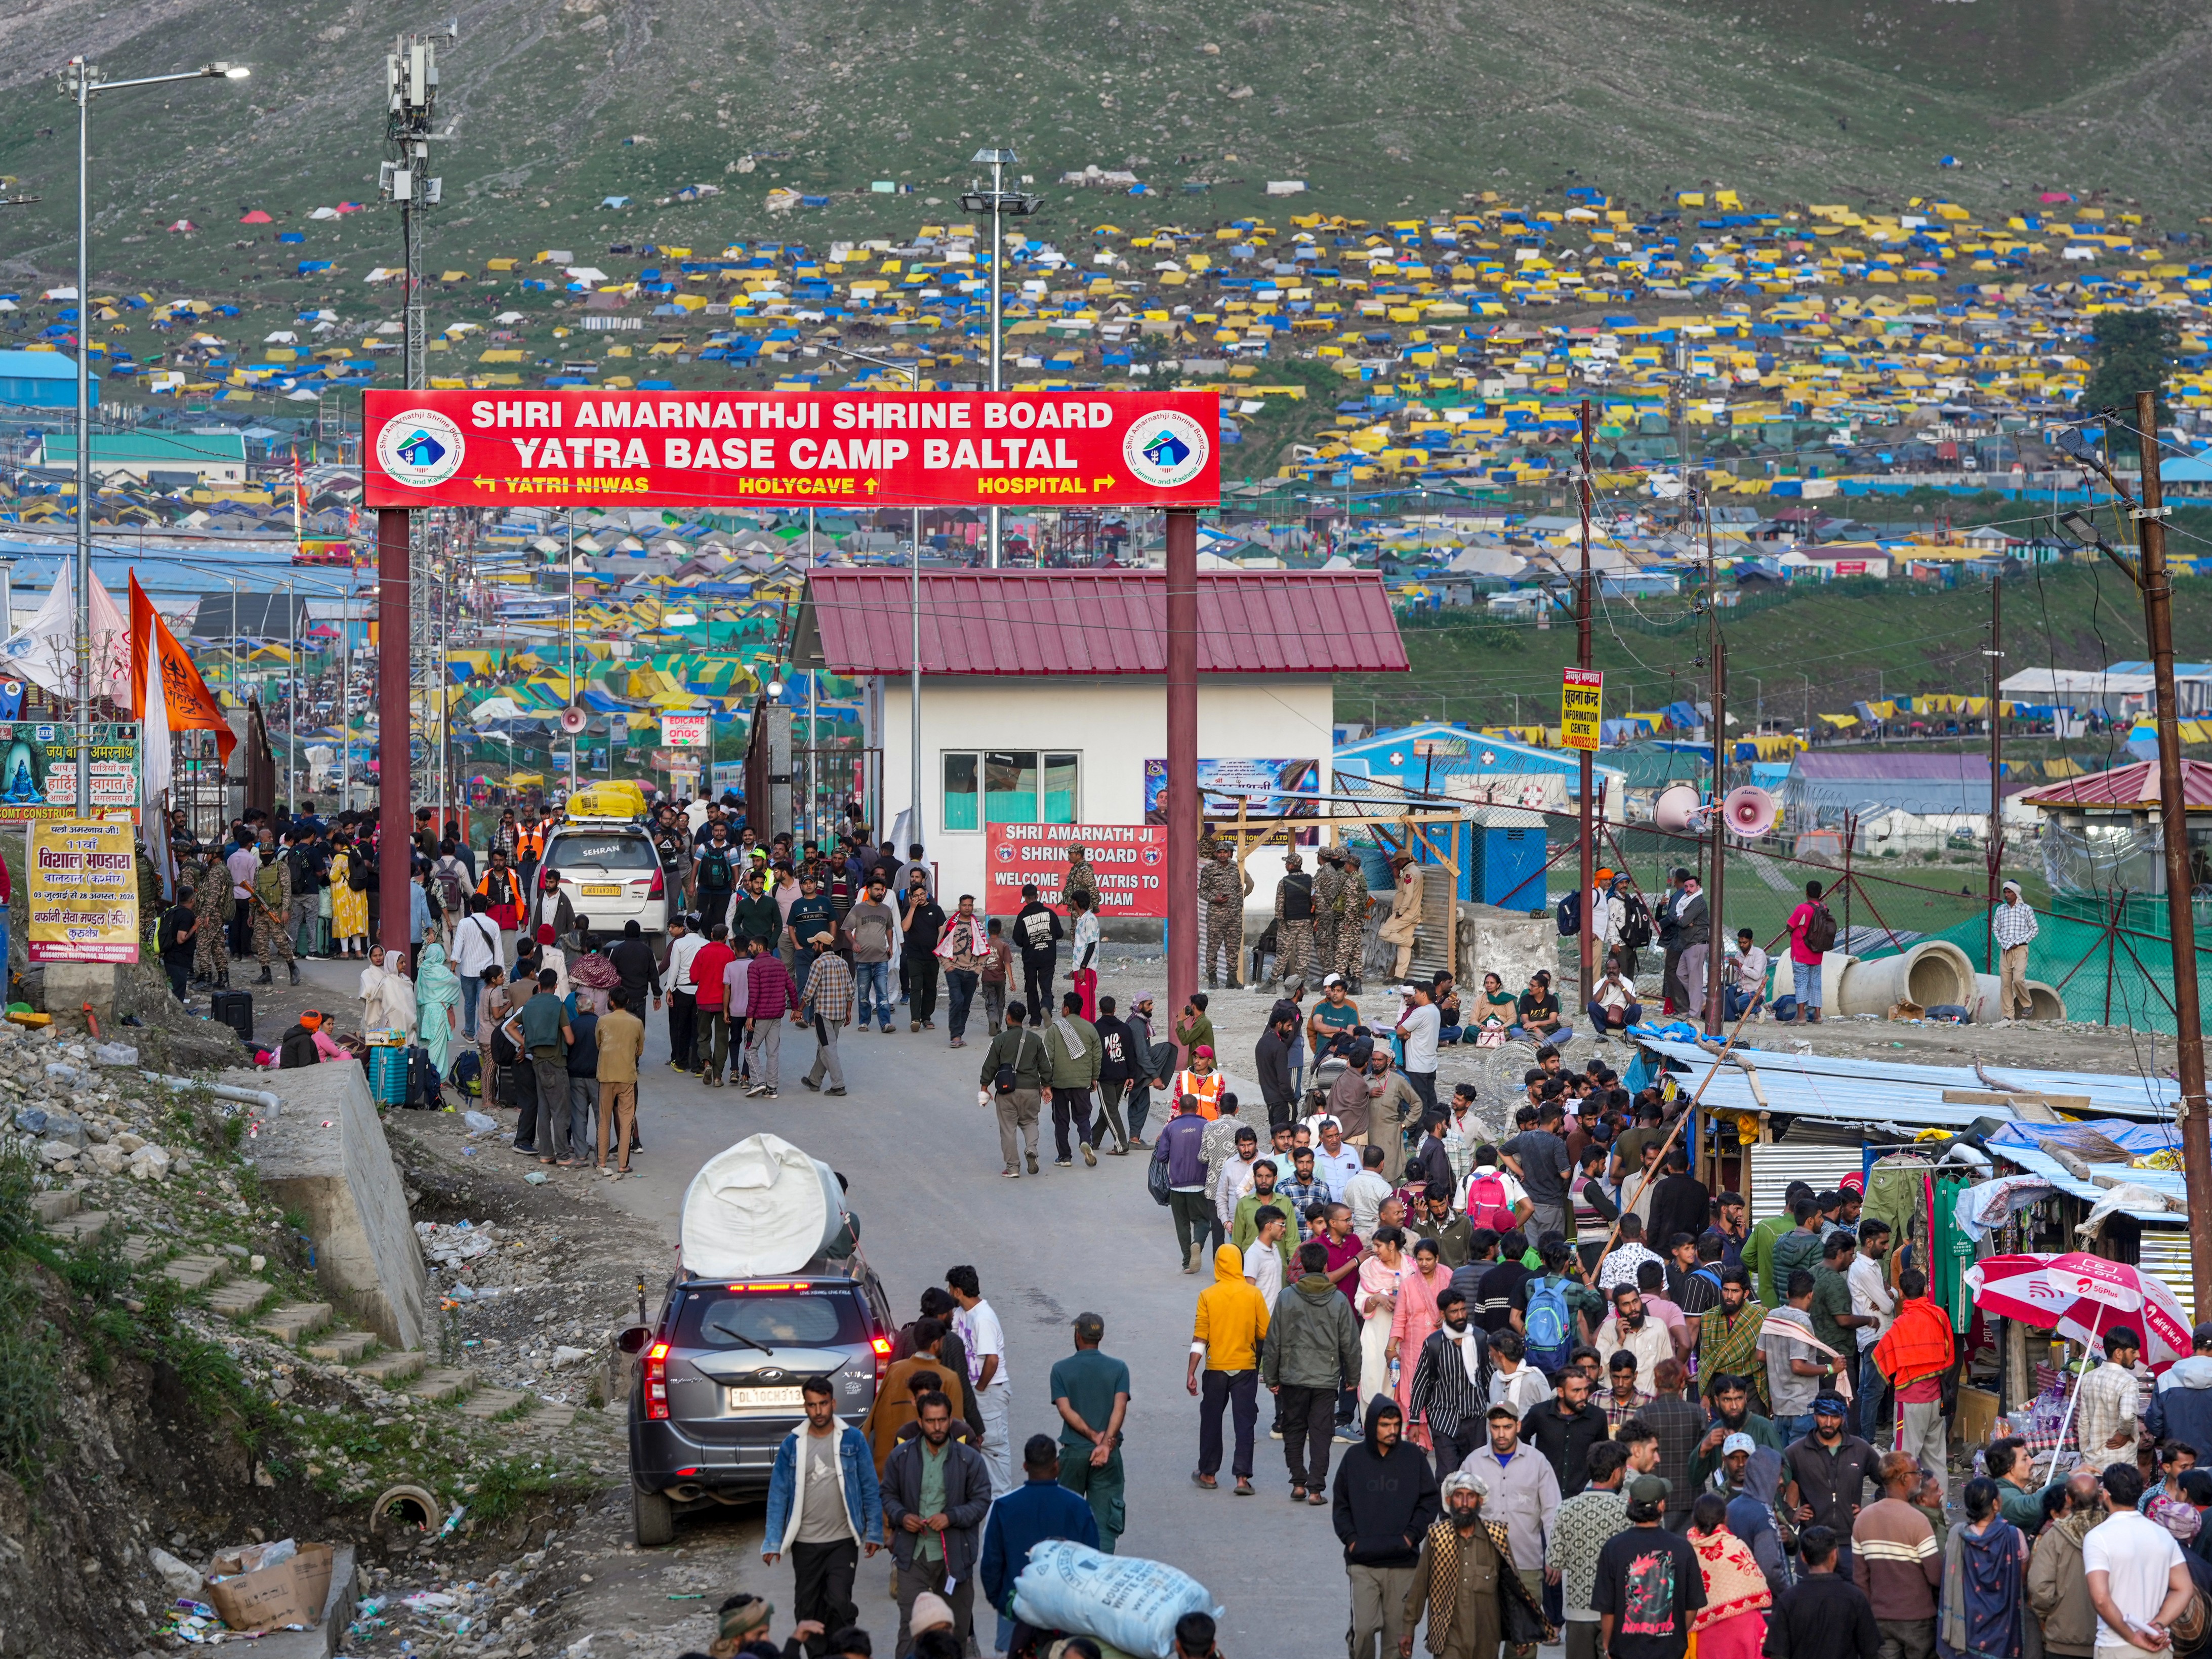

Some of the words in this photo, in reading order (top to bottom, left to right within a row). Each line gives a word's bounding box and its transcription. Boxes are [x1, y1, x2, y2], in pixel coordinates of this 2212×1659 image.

[472, 401, 561, 428] SHRI
[574, 401, 819, 429] AMARNATHJI
[833, 402, 971, 429] SHRINE
[985, 402, 1113, 429] BOARD
[380, 434, 388, 449] Shri
[386, 412, 424, 434] Amarnathji
[427, 412, 450, 428] Shrine
[449, 427, 462, 449] Board
[1126, 435, 1134, 449] Shri
[1132, 413, 1169, 434] Amarnathji
[1172, 413, 1194, 428] Shrine
[1194, 428, 1206, 449] Board
[511, 438, 651, 468] YATRA
[665, 438, 775, 469] BASE
[789, 438, 909, 470] CAMP
[924, 438, 1078, 471] BALTAL
[388, 467, 411, 483] Jammu
[428, 466, 454, 483] Kashmir
[1133, 468, 1156, 483] Jammu
[1173, 466, 1198, 483] Kashmir
[504, 477, 568, 493] YATRI
[577, 477, 649, 493] NIWAS
[739, 477, 855, 494] HOLYCAVE
[978, 477, 1087, 494] HOSPITAL
[1566, 671, 1581, 684] जयपुर
[1582, 673, 1600, 683] भण्डारा
[1565, 689, 1583, 708] सूचना
[1584, 687, 1599, 707] केन्द्र
[1564, 709, 1597, 722] INFORMATION
[1571, 723, 1590, 734] CENTRE
[1562, 734, 1597, 749] 9414008822-23
[46, 746, 63, 758] जय
[91, 746, 133, 758] अमरनाथ
[52, 764, 67, 772] आप
[91, 763, 116, 772] यात्रियों
[119, 764, 130, 772] का
[90, 776, 122, 791] स्वागत
[126, 774, 134, 791] है
[49, 793, 73, 802] आपकी
[94, 793, 122, 802] मंगलमय
[125, 793, 133, 802] हो
[51, 824, 67, 834] चलो
[69, 826, 103, 834] अमरनाथ
[105, 825, 119, 834] जी!
[1005, 825, 1042, 840] SHRI
[1047, 826, 1134, 842] AMARNATH
[1138, 828, 1153, 843] JI
[67, 837, 97, 849] 11वाँ
[583, 845, 620, 857] SEHRAN
[39, 847, 83, 868] विशाल
[86, 852, 131, 869] भण्डारा
[1021, 846, 1070, 861] SHRIN
[1084, 848, 1137, 863] BOARD
[44, 873, 83, 884] बालटाल
[995, 872, 1059, 886] WELCOME
[1094, 874, 1138, 888] YATRIS
[1141, 875, 1159, 889] TO
[44, 890, 69, 901] जुलाई
[69, 891, 78, 899] से
[62, 909, 78, 924] सेवा
[80, 913, 105, 925] मण्डल
[68, 927, 99, 940] कुरुक्षेत्र
[1104, 1032, 1119, 1050] NO
[1110, 1047, 1122, 1062] NO
[2153, 1316, 2170, 1334] airtel
[1101, 1572, 1134, 1606] DOUBLE
[1112, 1582, 1138, 1609] WHITE
[1132, 1578, 1164, 1611] WEIGHT
[1621, 1621, 1675, 1635] NARUTO
